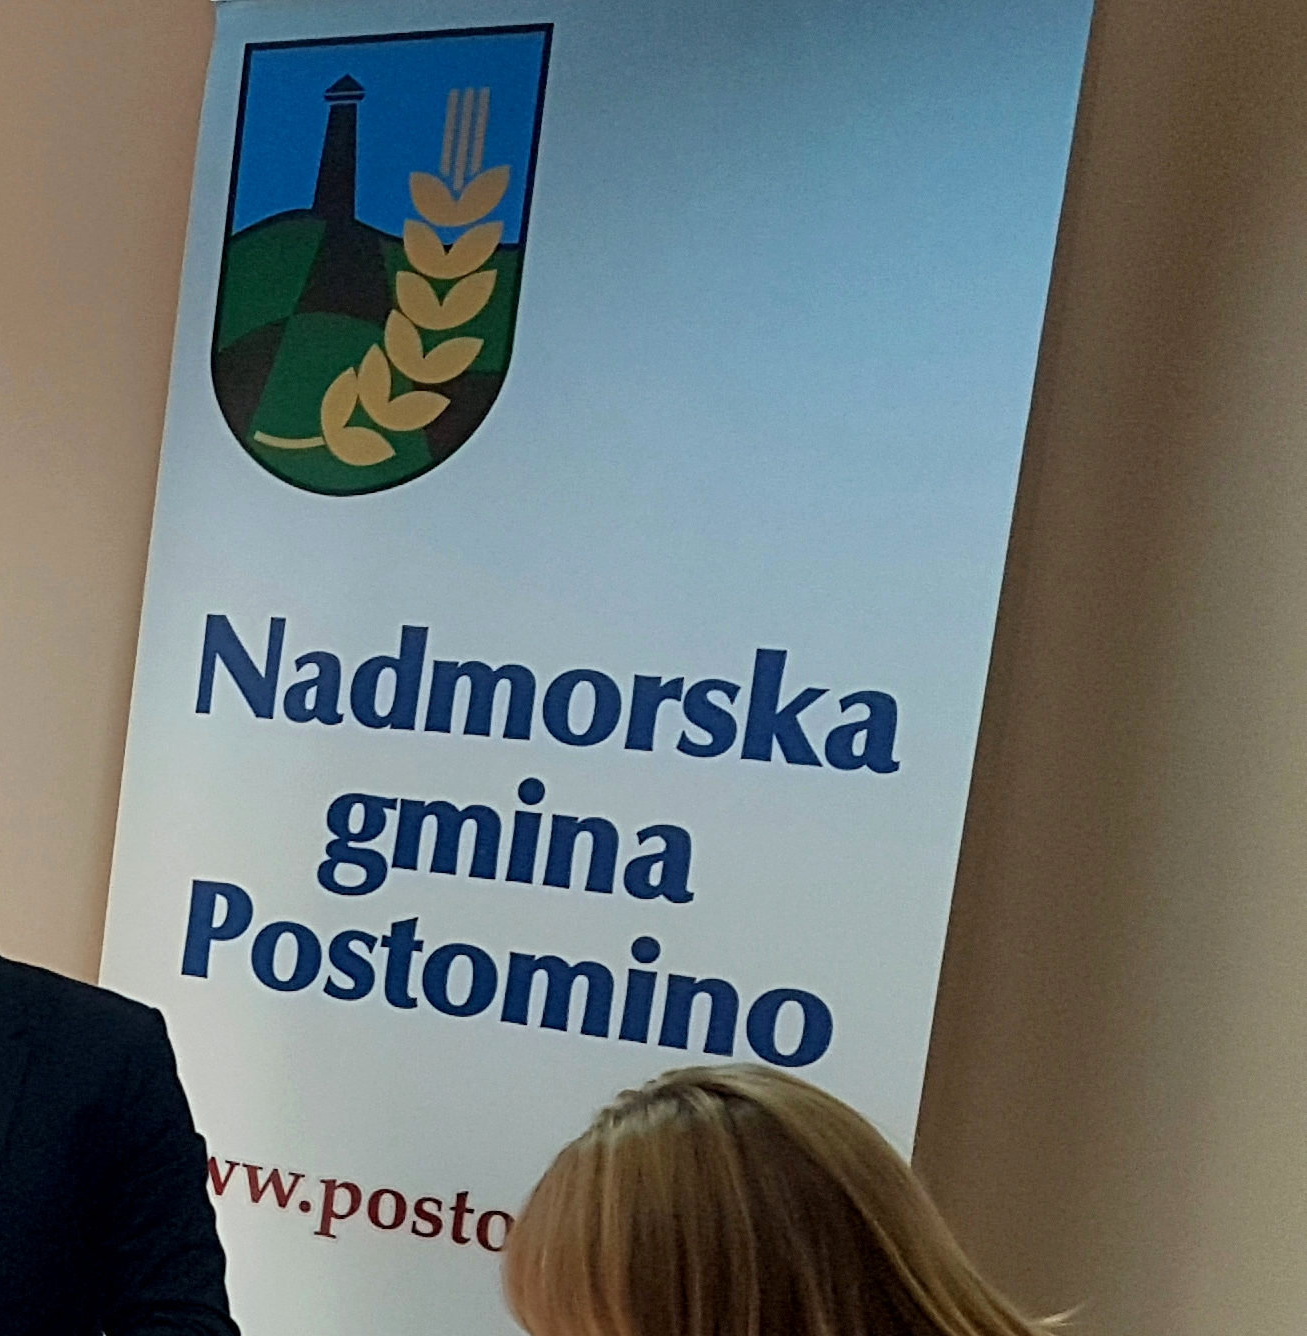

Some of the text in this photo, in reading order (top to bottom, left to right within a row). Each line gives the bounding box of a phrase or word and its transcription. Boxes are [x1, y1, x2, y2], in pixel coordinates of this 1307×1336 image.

[195, 613, 901, 775] Nadmorska
[316, 776, 695, 904] gmina
[181, 879, 834, 1068] Postomino
